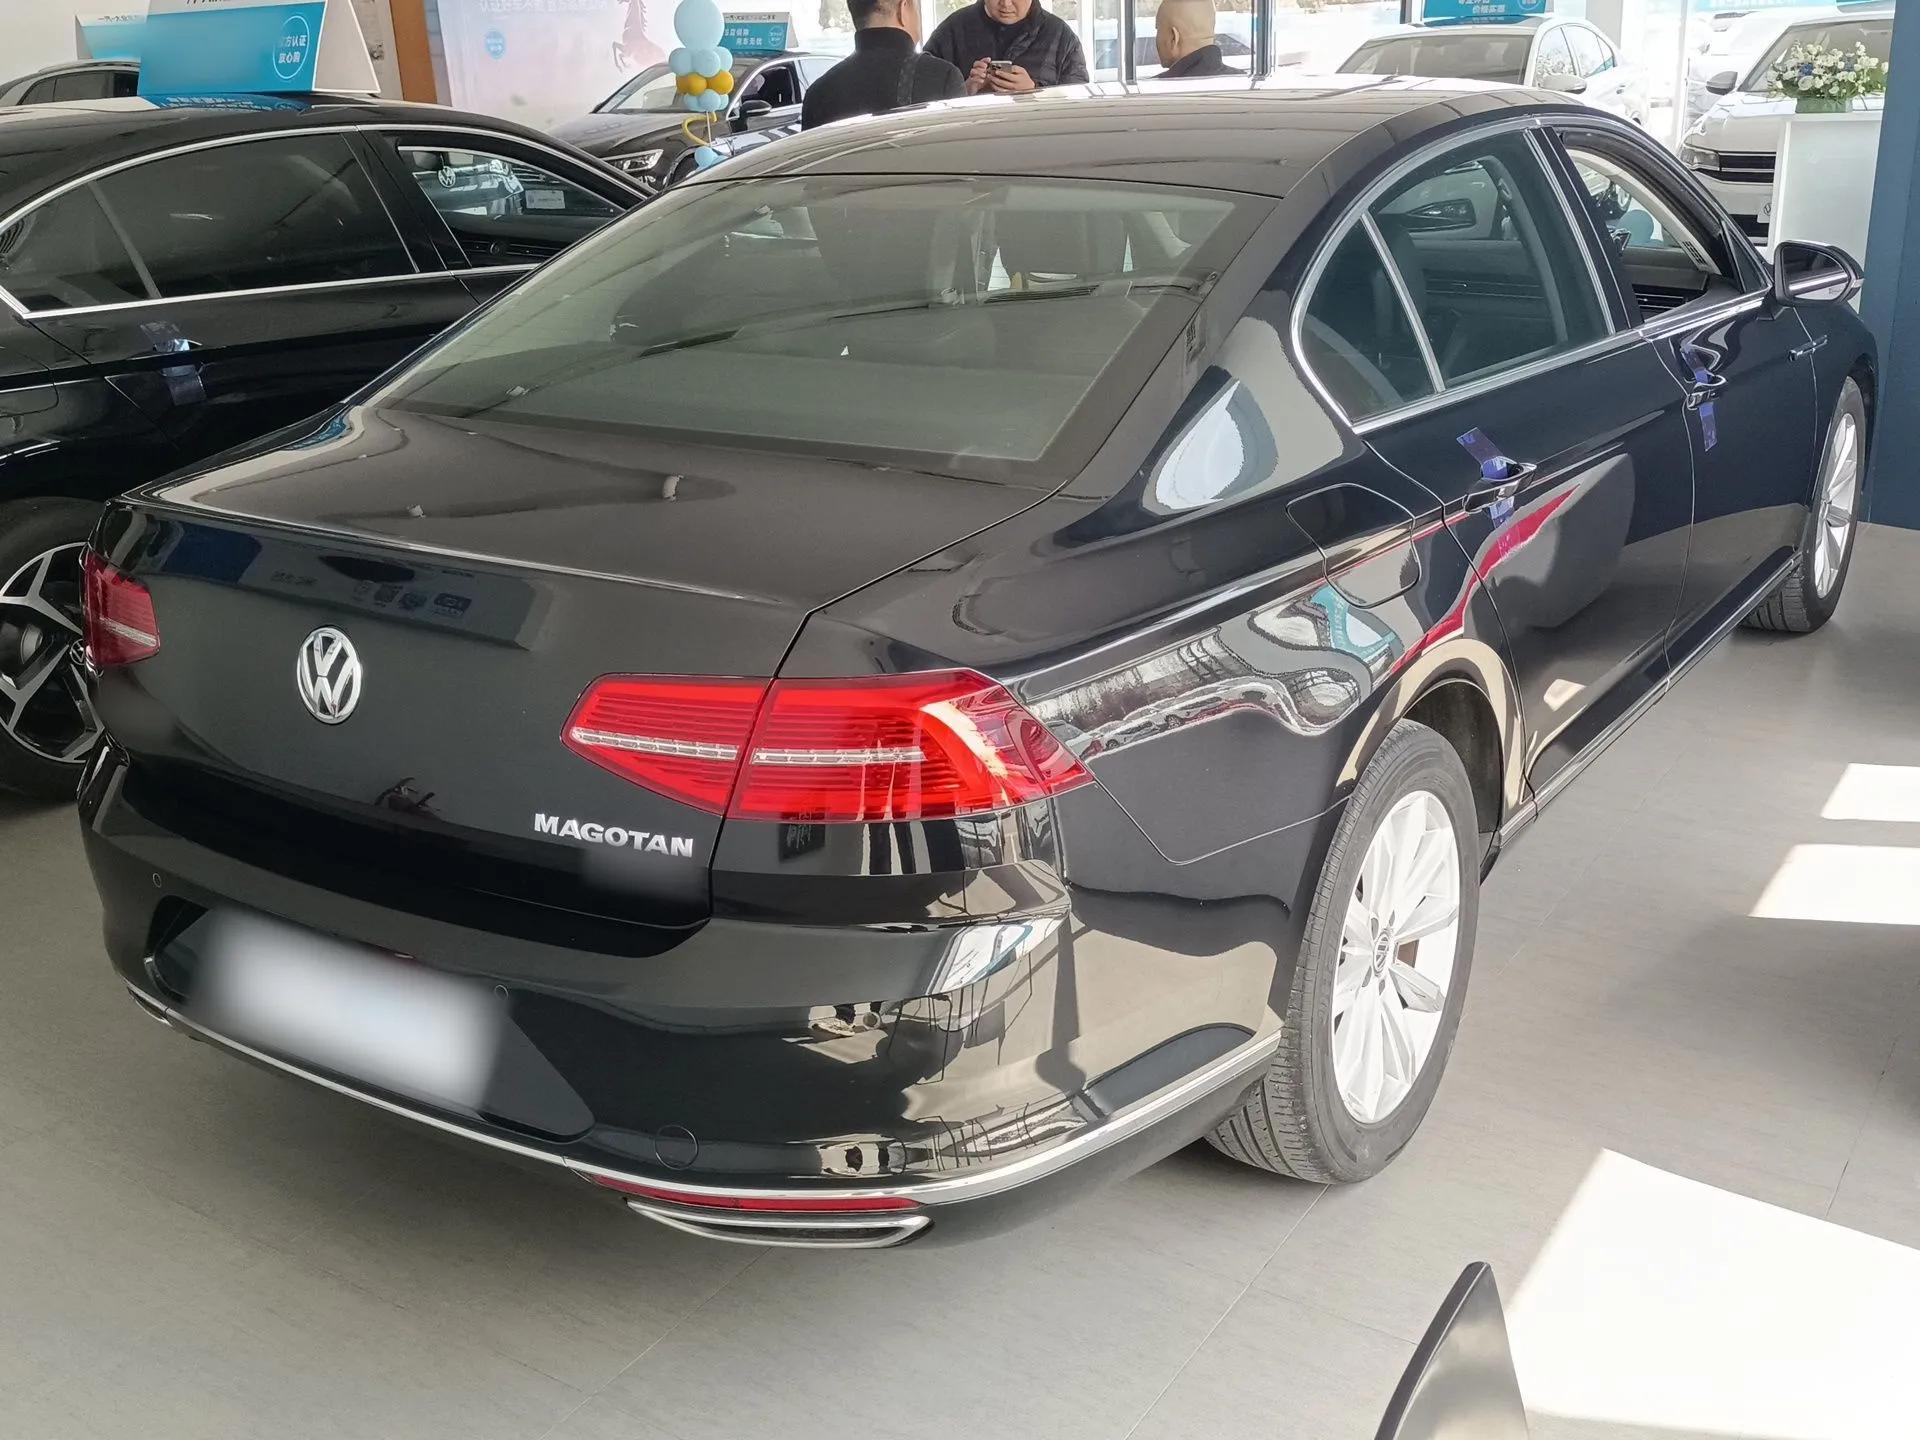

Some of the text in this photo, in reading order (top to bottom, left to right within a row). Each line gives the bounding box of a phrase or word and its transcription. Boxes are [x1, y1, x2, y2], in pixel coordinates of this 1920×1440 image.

[279, 35, 307, 47] 方认证
[534, 813, 694, 858] MAGOTAN
